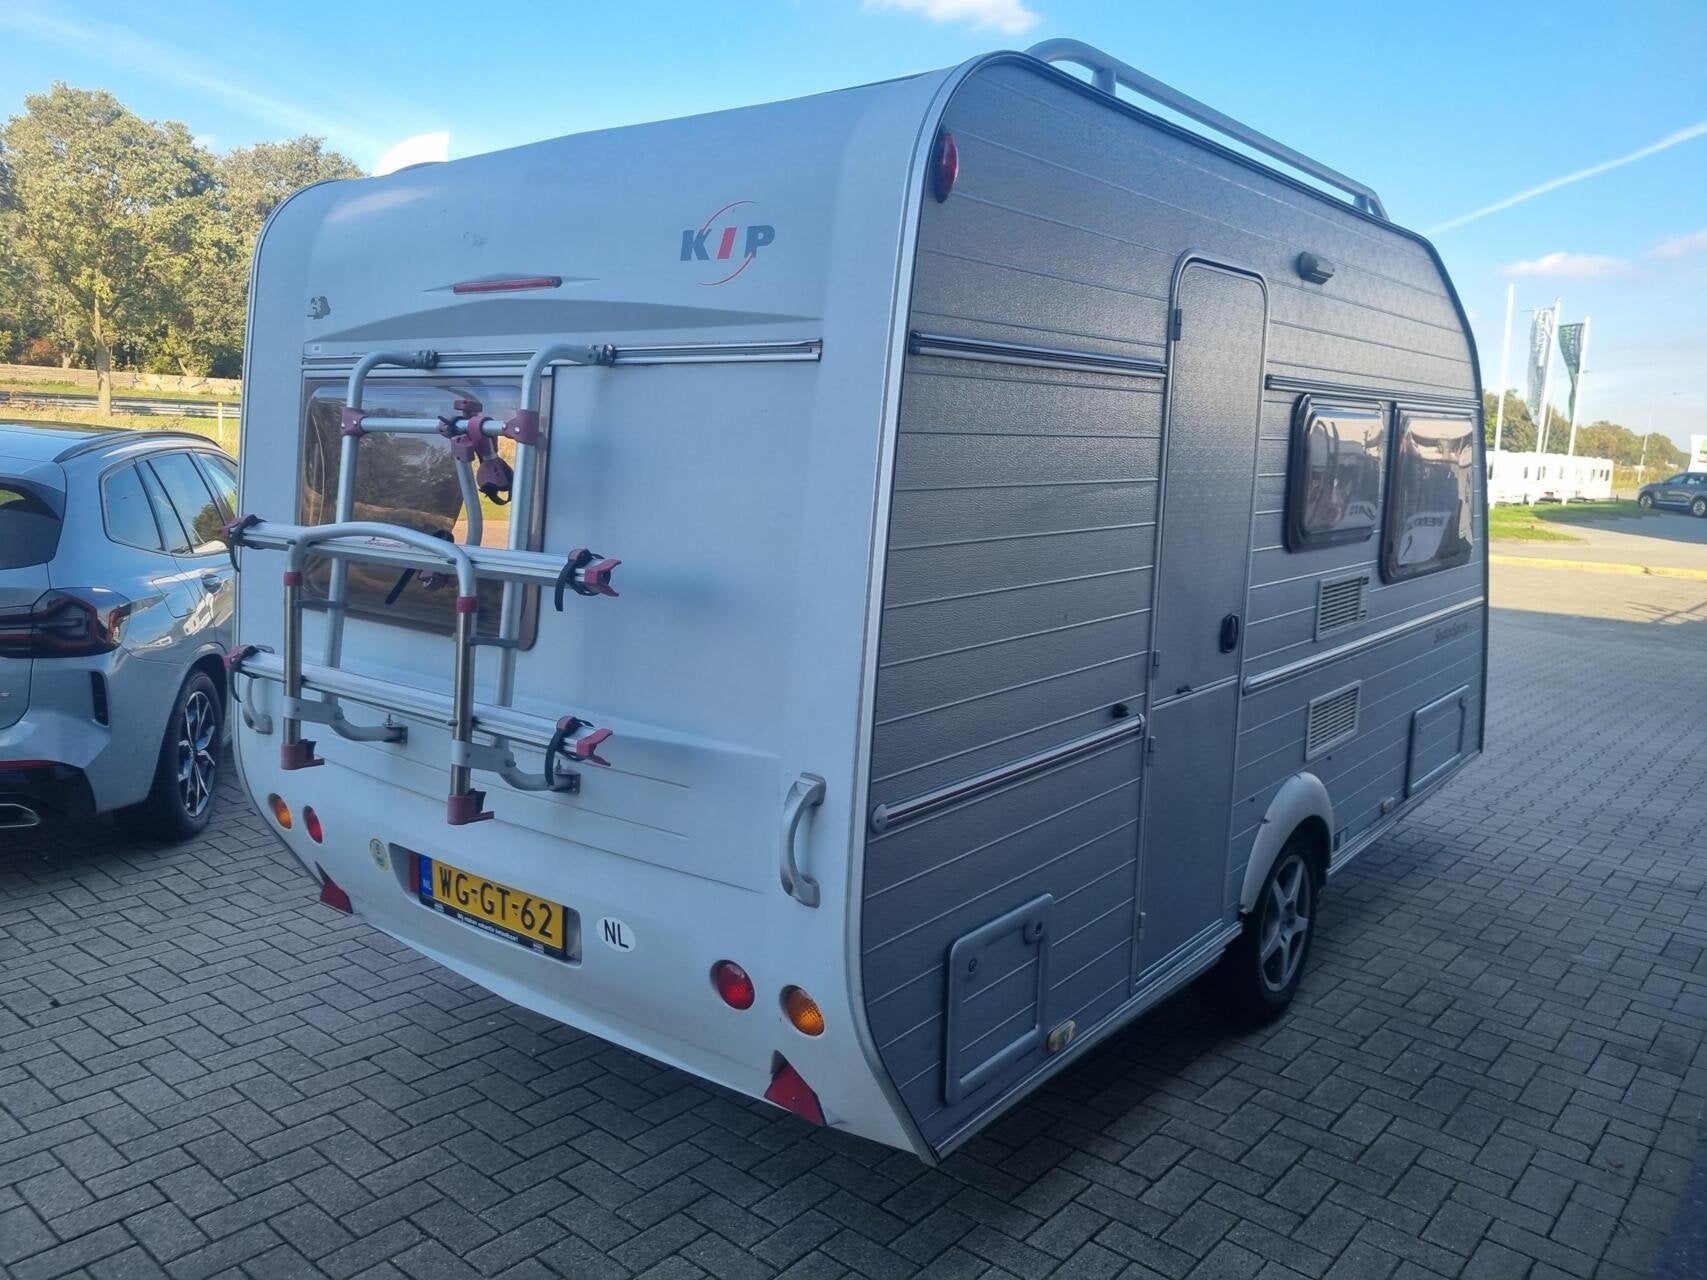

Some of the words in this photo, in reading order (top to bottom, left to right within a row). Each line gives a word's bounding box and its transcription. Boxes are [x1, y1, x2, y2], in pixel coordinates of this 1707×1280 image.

[680, 225, 775, 261] KIP
[422, 878, 432, 890] NL
[439, 866, 553, 939] WG-GT-62
[604, 919, 629, 949] NL
